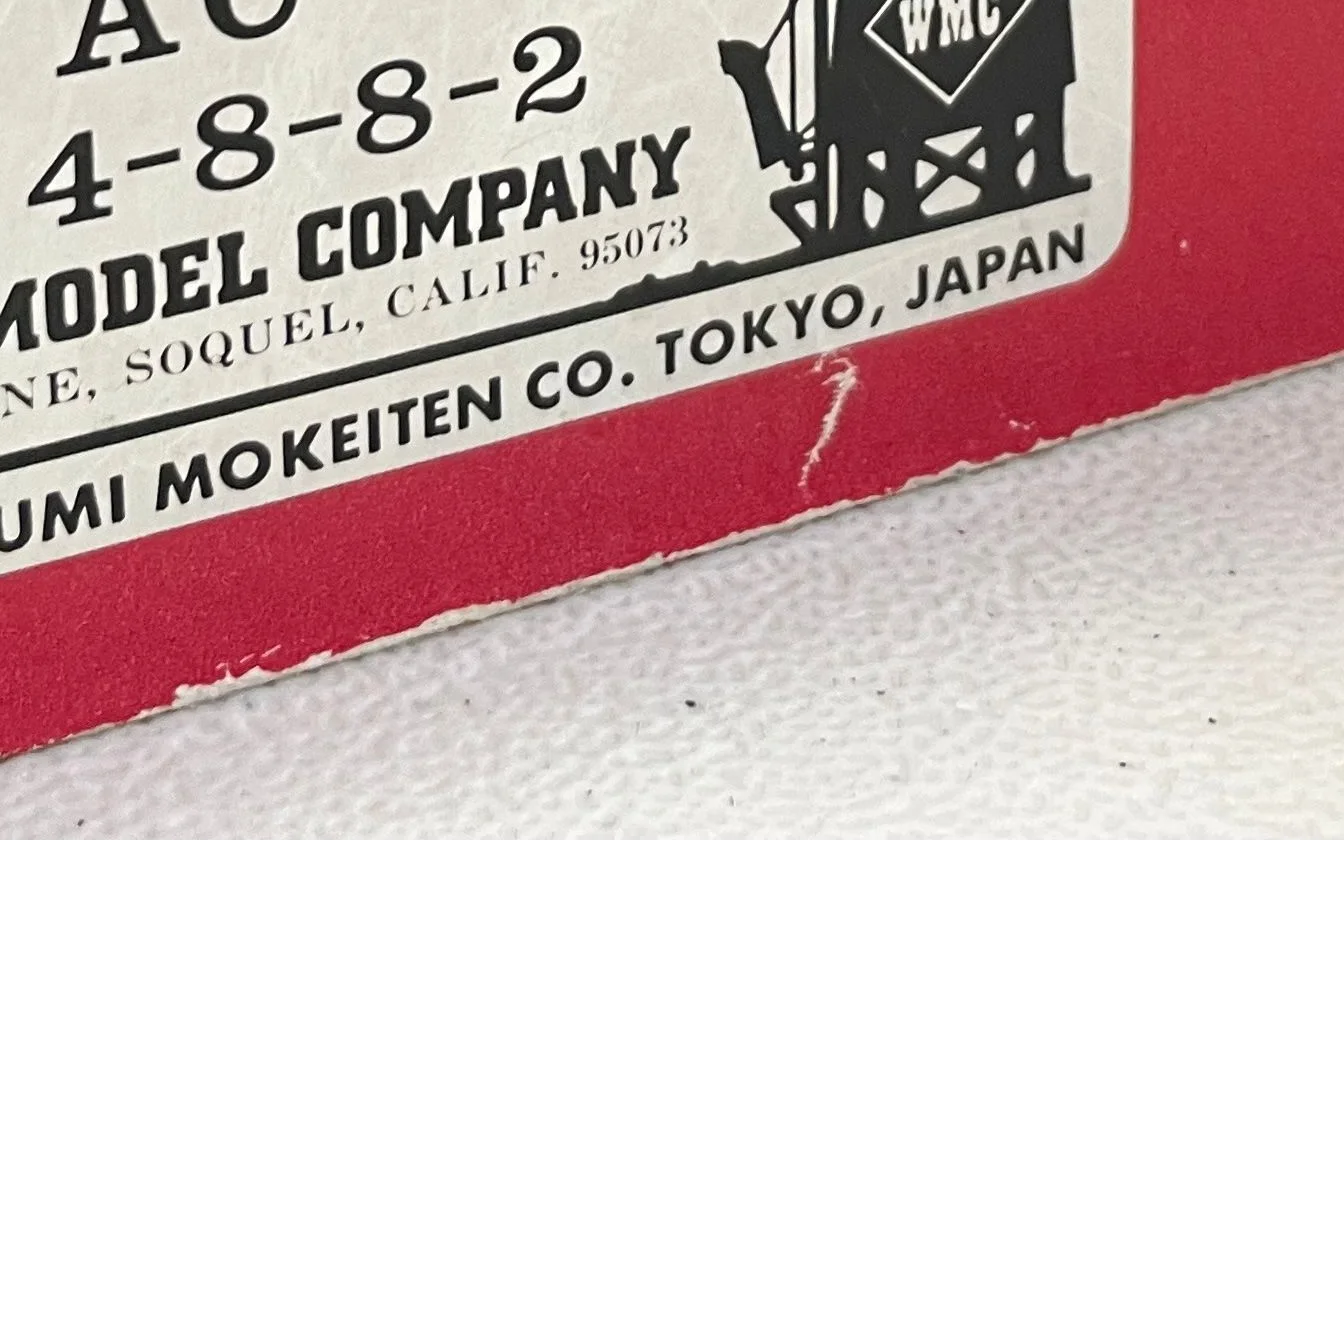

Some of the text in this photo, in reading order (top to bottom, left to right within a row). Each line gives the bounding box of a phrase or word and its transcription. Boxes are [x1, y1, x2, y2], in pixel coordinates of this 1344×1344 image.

[26, 25, 588, 228] 4-8-8-2
[296, 125, 692, 283] COMPANY
[125, 301, 365, 386] SOQUEL,
[386, 249, 561, 319] CALIF.
[579, 215, 689, 269] 95073
[154, 375, 503, 513] MOKEITEN
[525, 349, 635, 411] CO.
[654, 283, 885, 377] TOKYO,
[905, 222, 1085, 311] JAPAN
